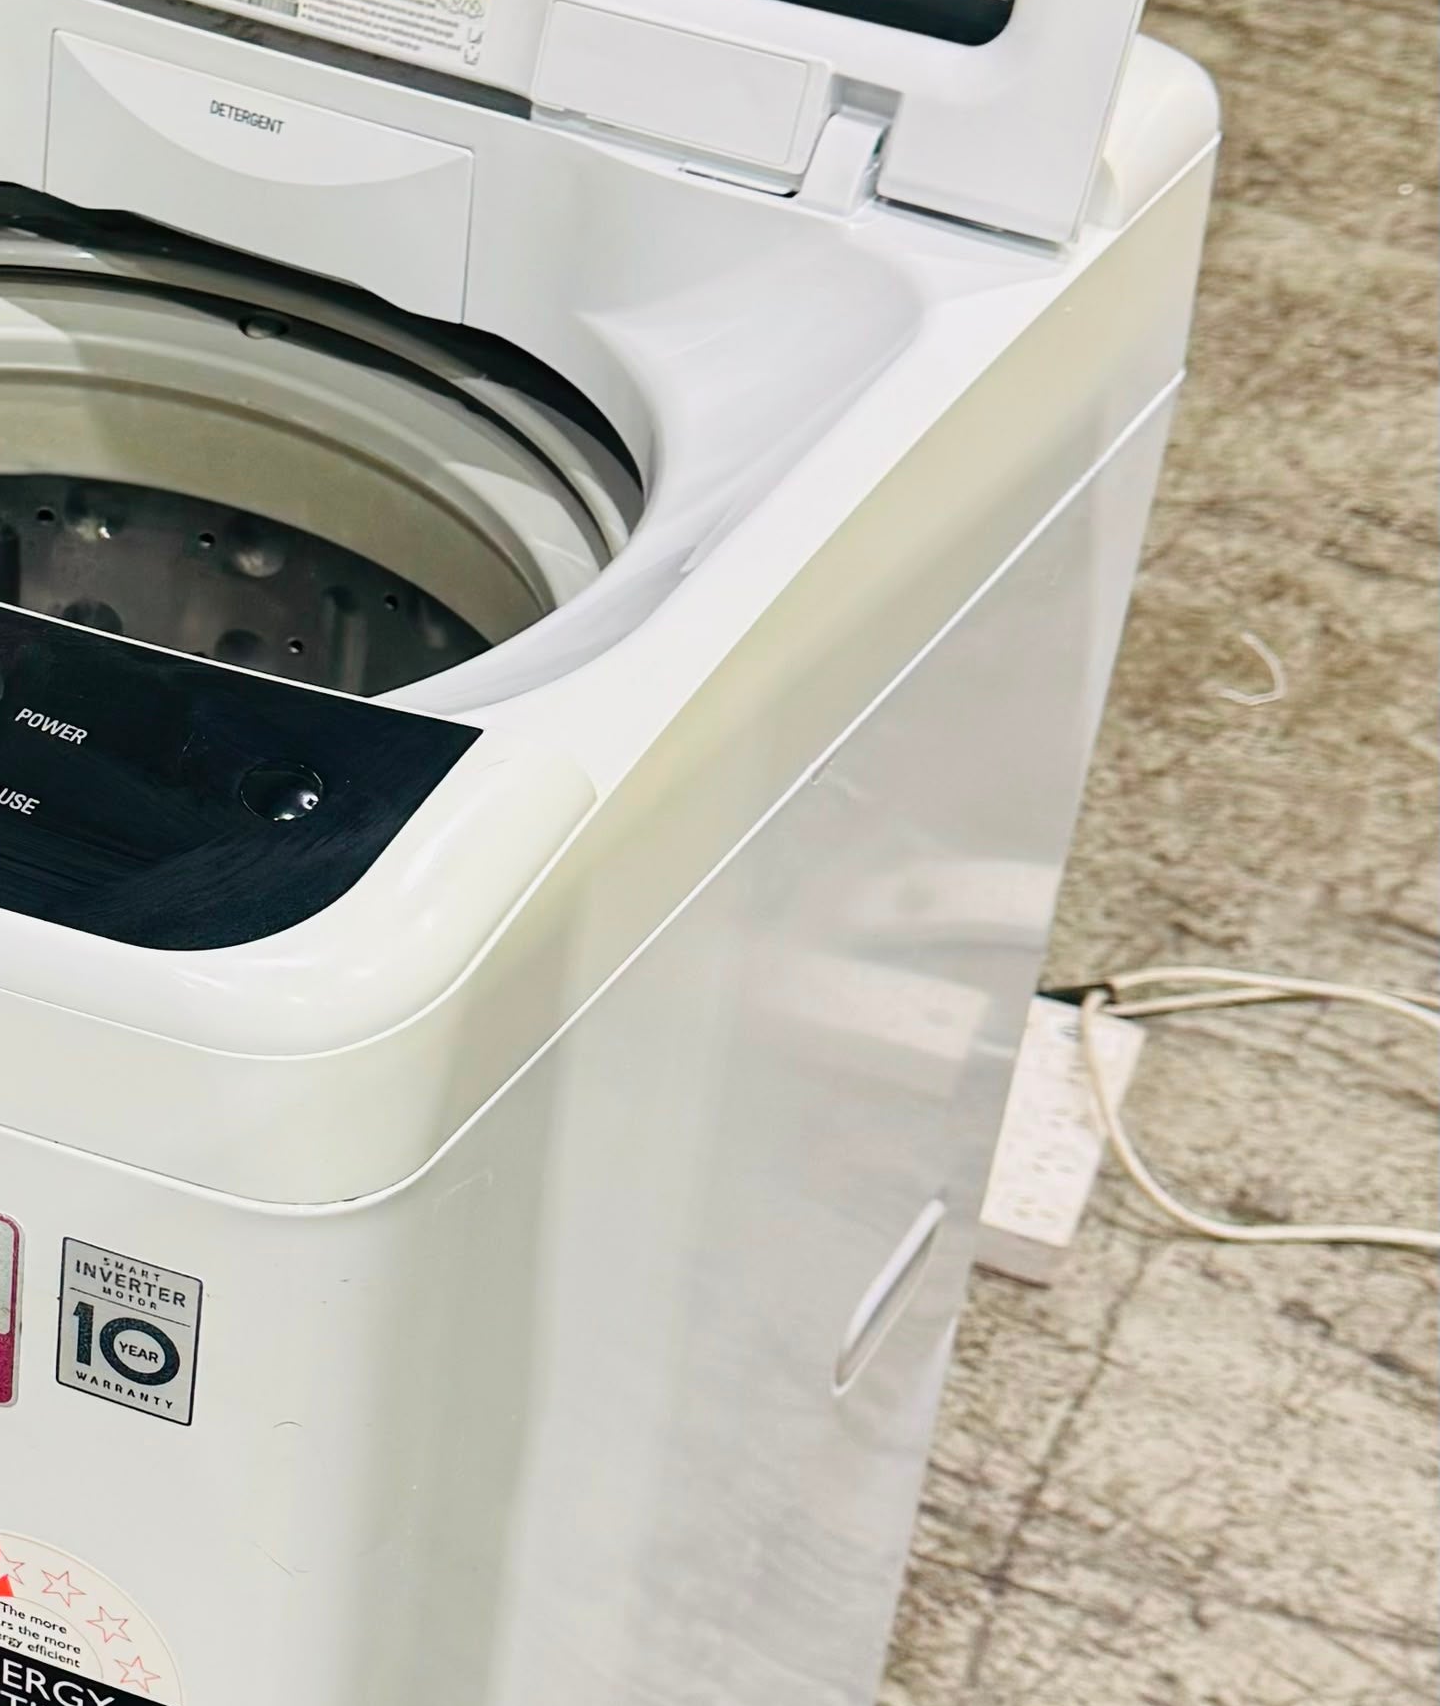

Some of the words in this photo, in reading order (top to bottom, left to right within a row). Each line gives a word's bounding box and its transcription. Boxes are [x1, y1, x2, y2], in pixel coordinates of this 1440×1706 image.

[210, 99, 285, 134] DETERGENT
[14, 707, 89, 745] POWER
[75, 1259, 187, 1309] INVERTER
[103, 1256, 162, 1282] SMART
[102, 1286, 158, 1311] MOTOR
[72, 1300, 182, 1387] 10
[118, 1340, 160, 1364] YEAR
[75, 1369, 174, 1410] WARRANTY
[0, 1601, 26, 1619] The
[30, 1615, 67, 1634] more
[18, 1625, 40, 1640] the
[44, 1636, 81, 1654] more
[27, 1643, 80, 1668] efficient
